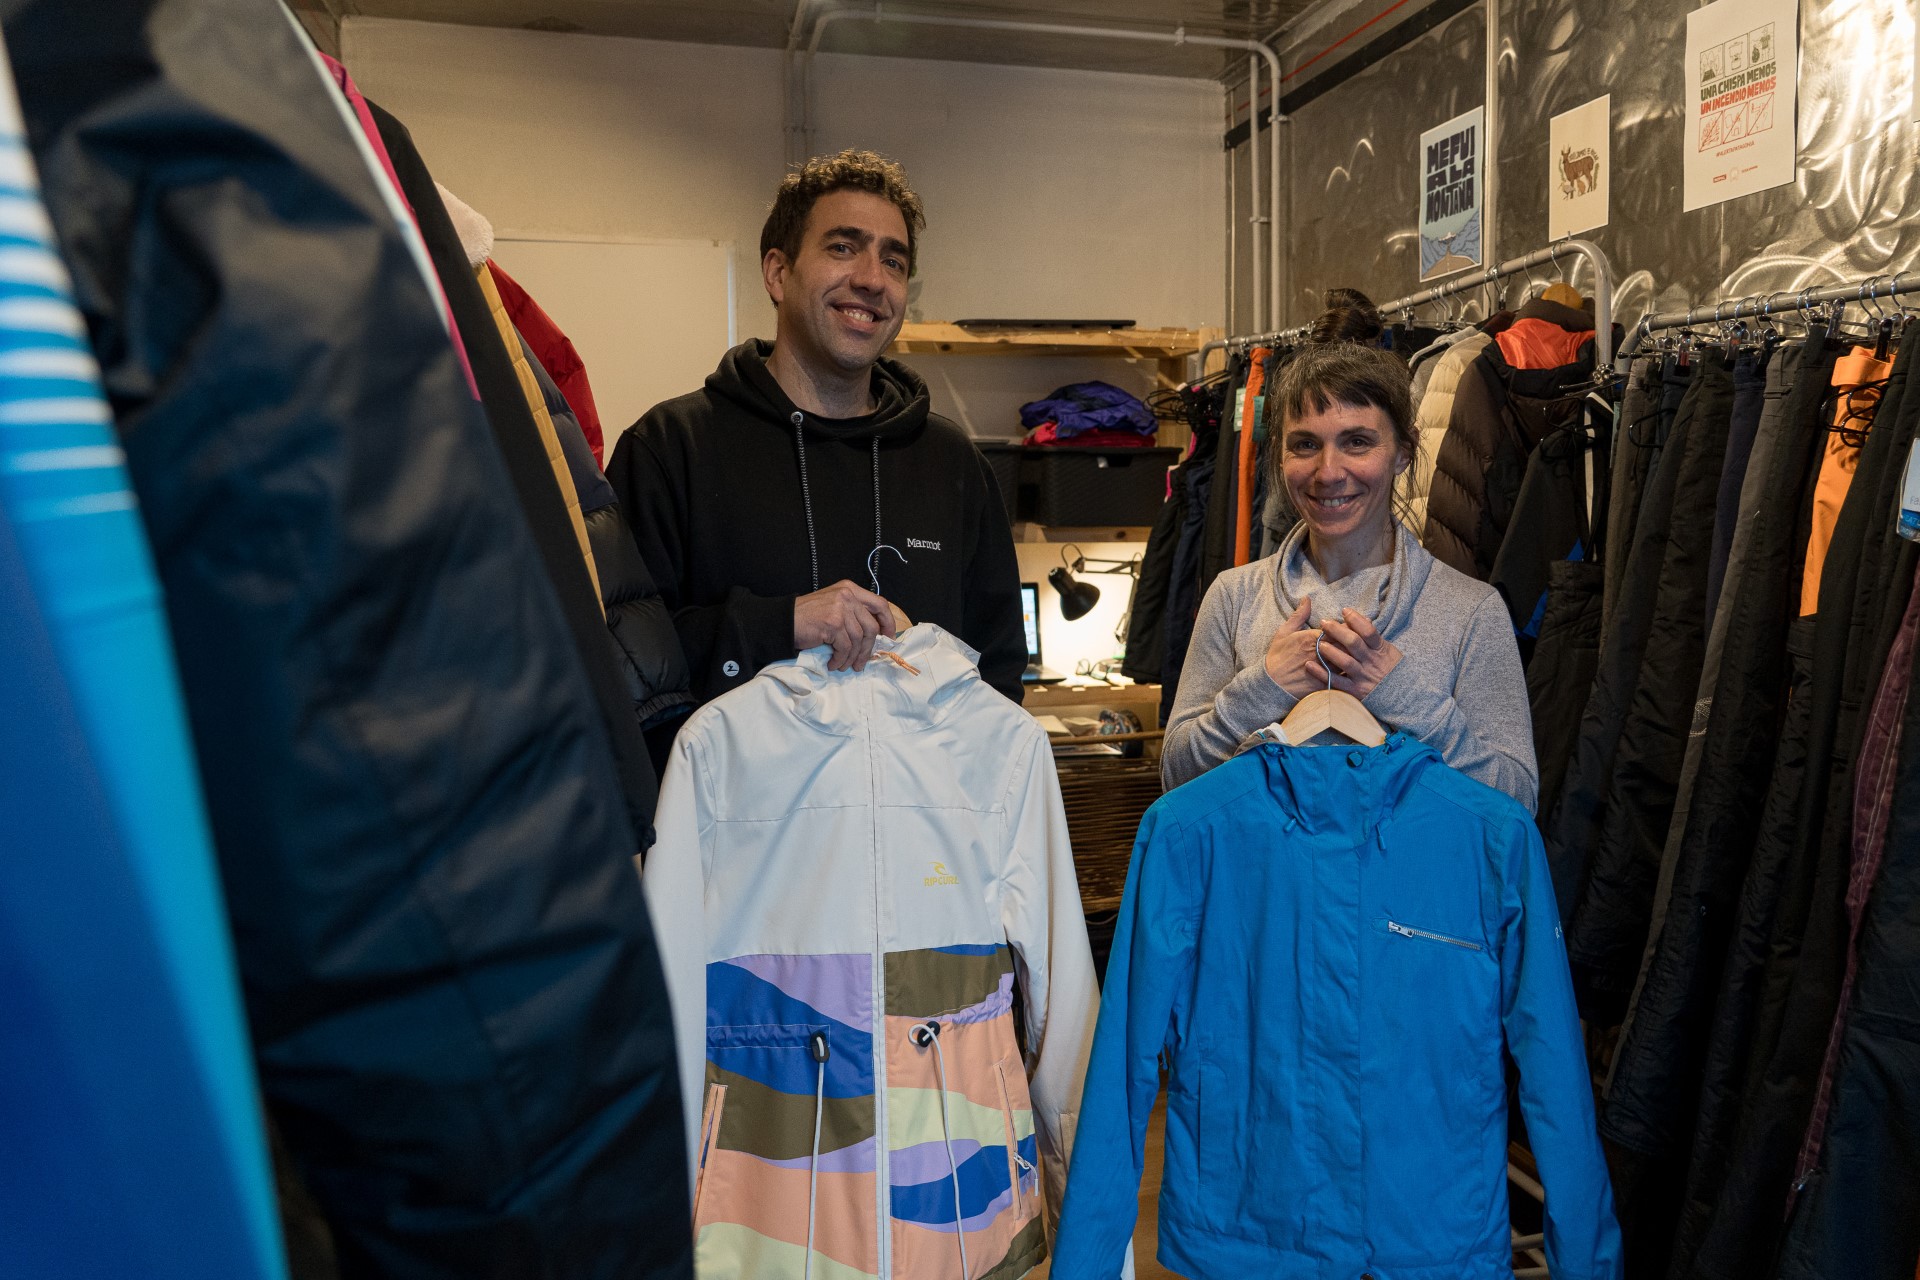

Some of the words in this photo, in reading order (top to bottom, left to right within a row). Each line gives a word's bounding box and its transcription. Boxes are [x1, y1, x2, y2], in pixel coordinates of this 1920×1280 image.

[1701, 84, 1717, 101] UNA
[1718, 74, 1745, 95] CHISPA
[1747, 61, 1777, 84] MENOS
[1701, 101, 1712, 115] UN
[1712, 87, 1746, 111] INCENDIO
[1747, 76, 1777, 99] MENOS
[907, 538, 941, 551] Marmot
